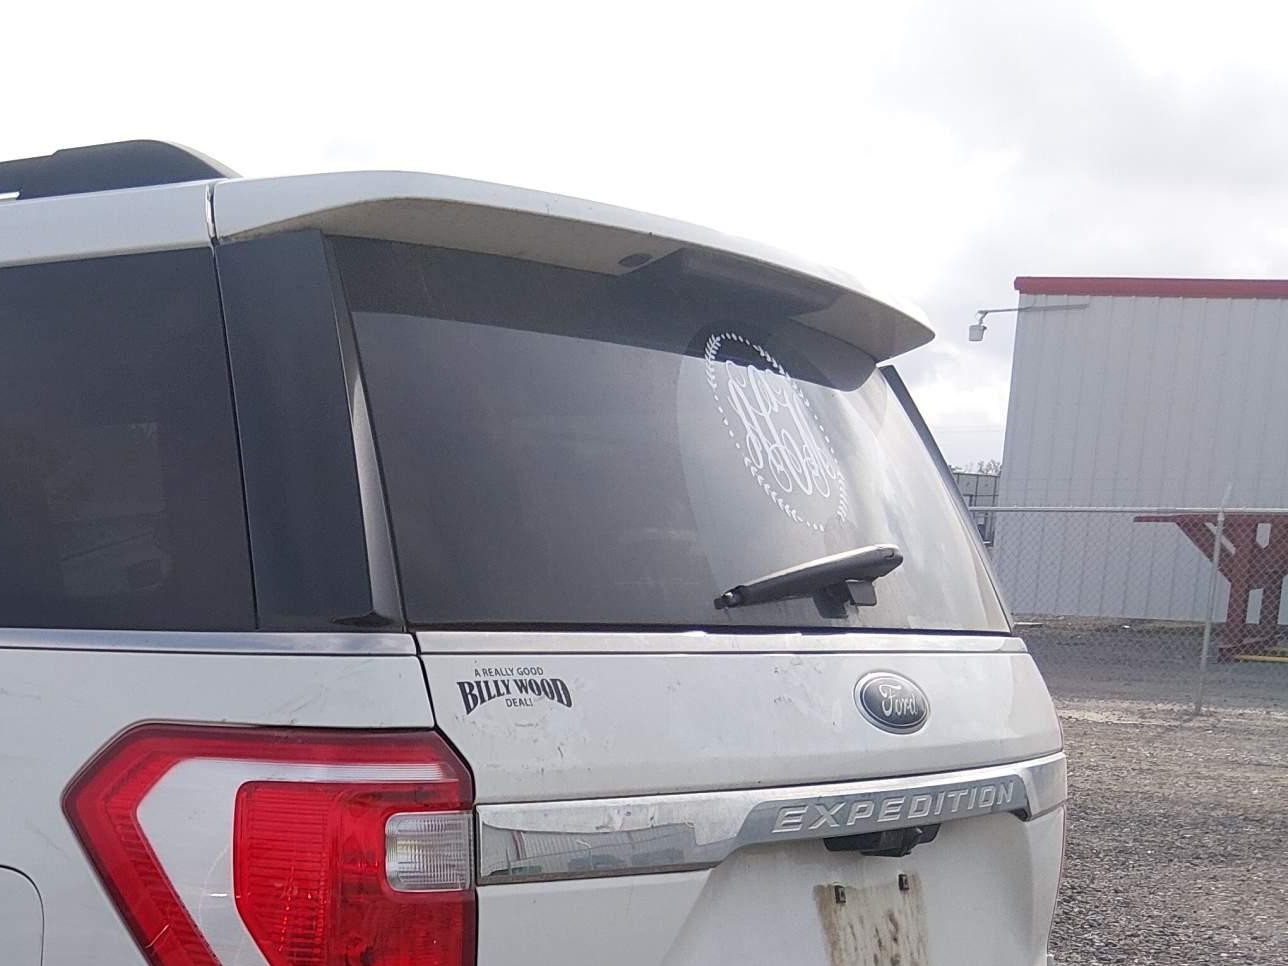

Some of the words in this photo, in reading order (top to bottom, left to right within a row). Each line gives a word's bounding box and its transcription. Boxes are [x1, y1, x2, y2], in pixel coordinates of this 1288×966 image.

[474, 669, 481, 678] A
[482, 668, 514, 678] REALLY
[516, 667, 544, 677] GOOD
[456, 679, 512, 716] BILLY
[513, 678, 573, 709] WOOD
[505, 698, 534, 708] DEAL!
[879, 683, 918, 718] Ford
[771, 782, 1015, 834] EXPEDITION
